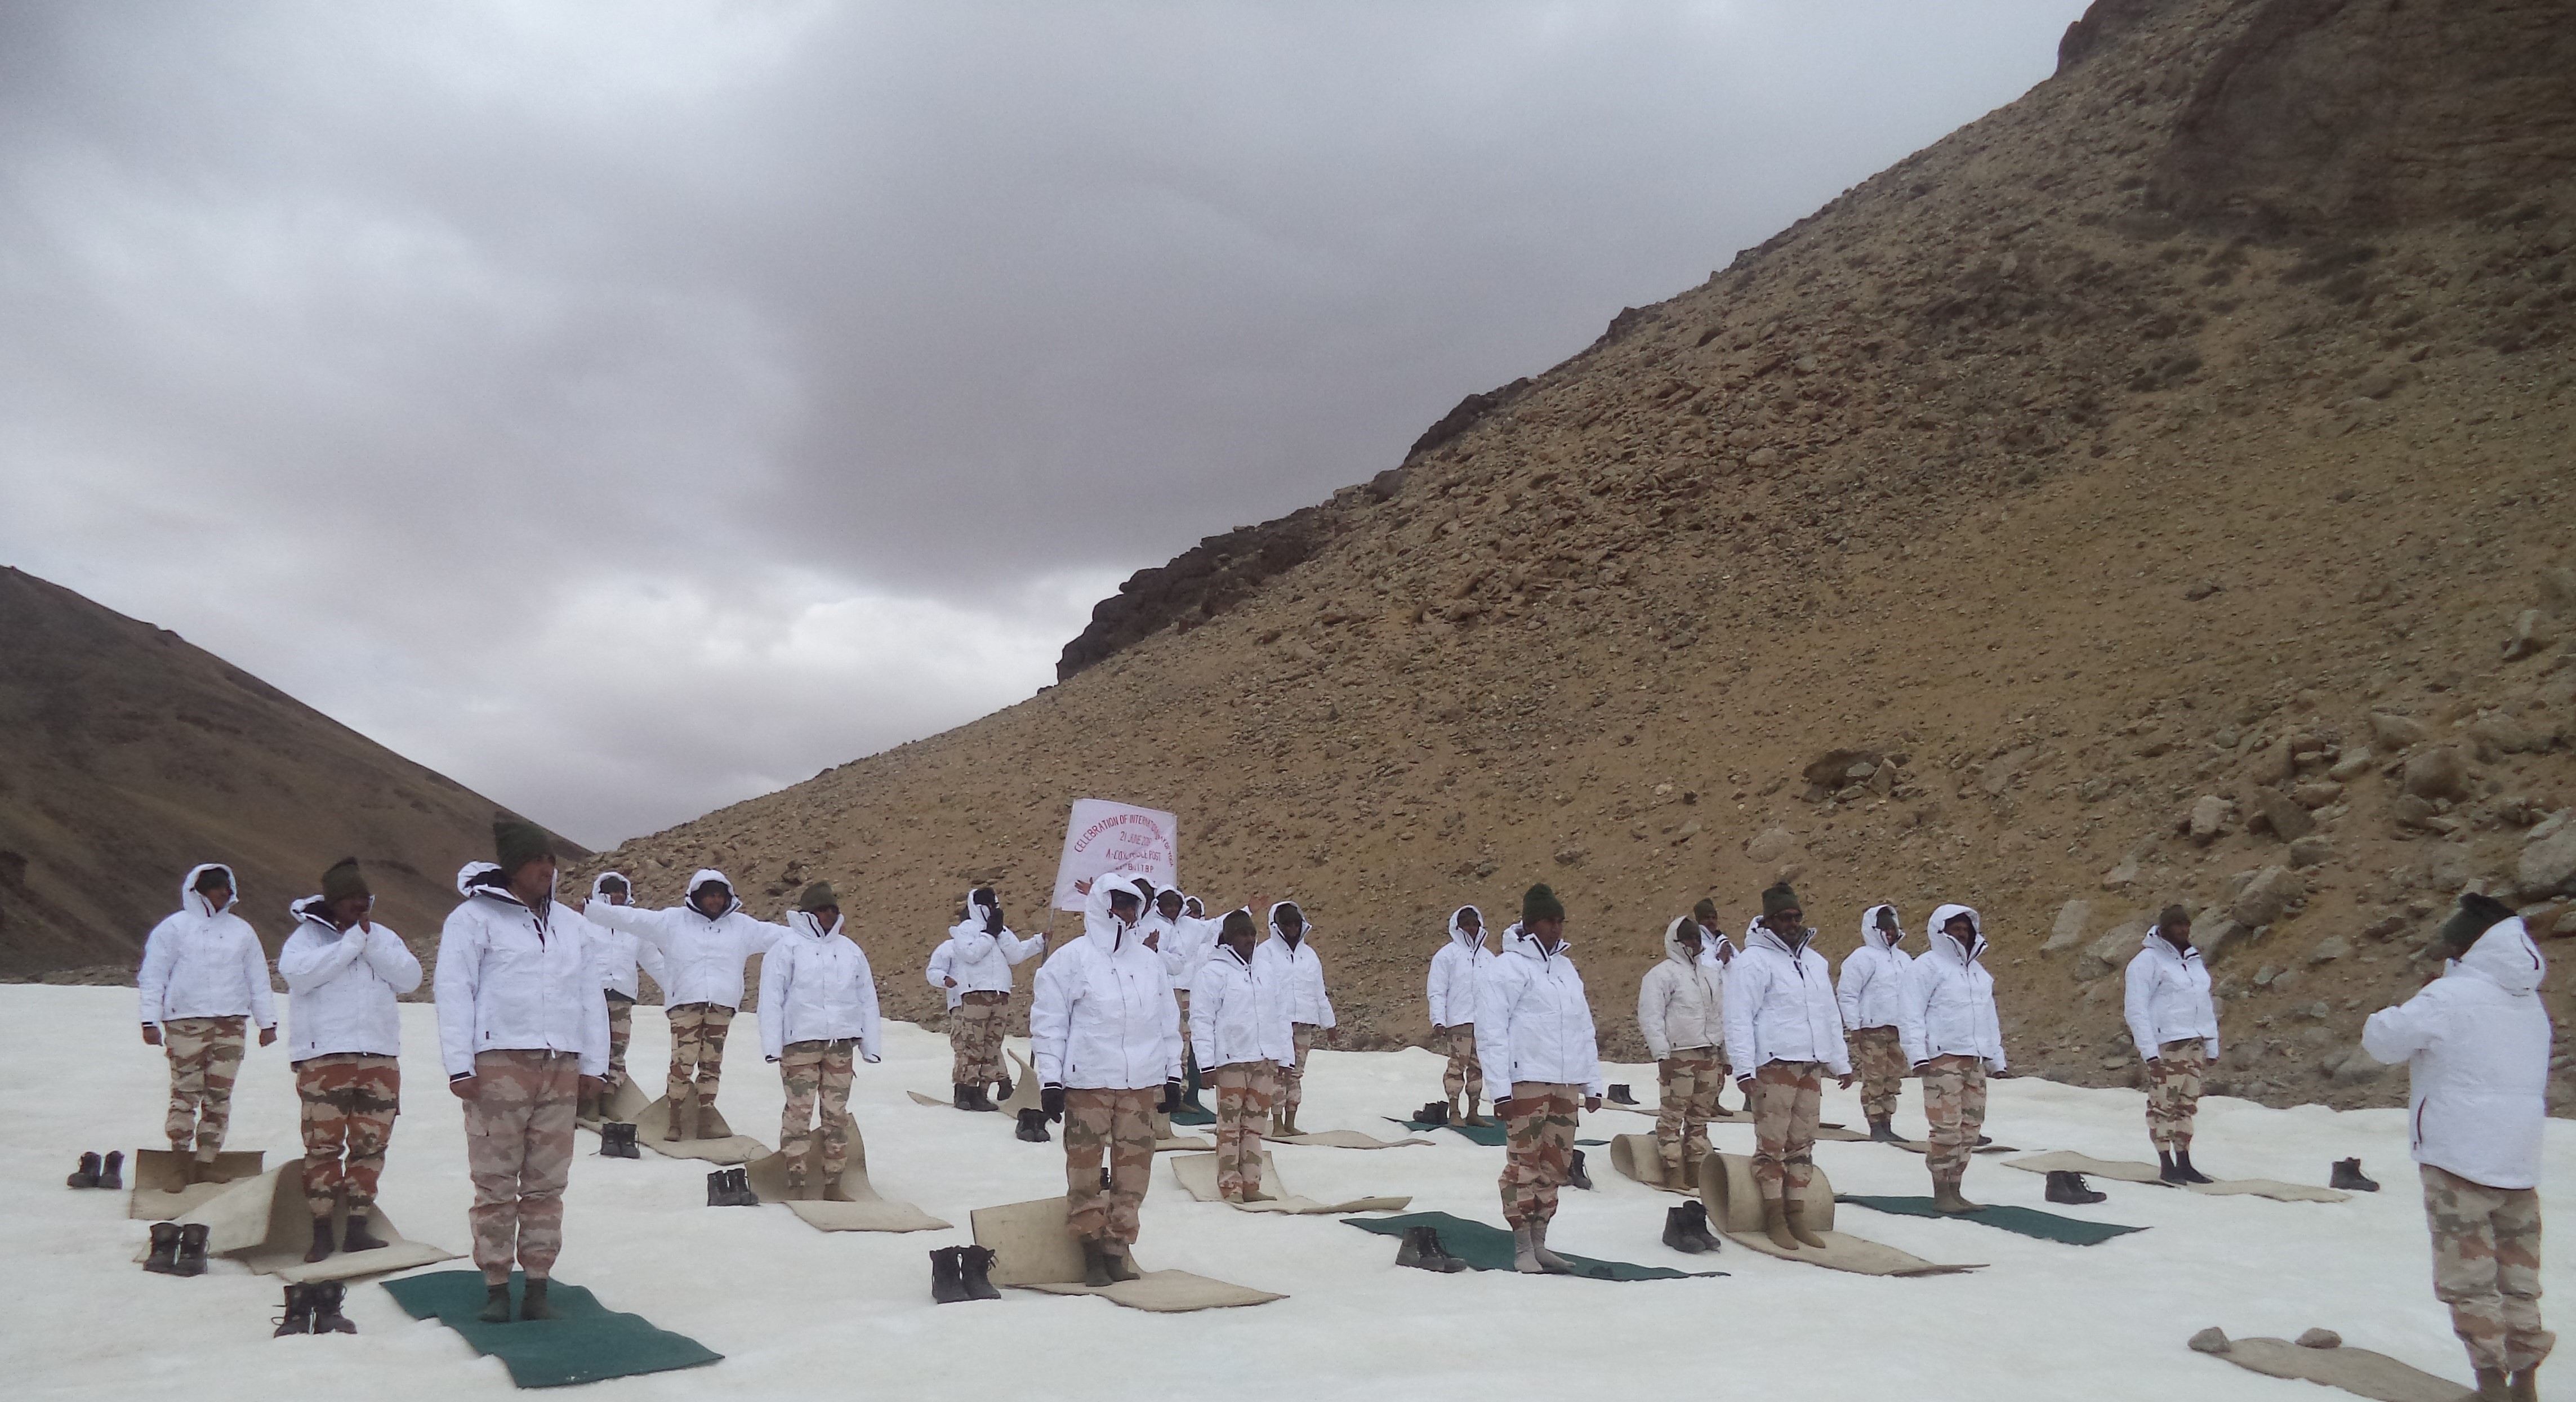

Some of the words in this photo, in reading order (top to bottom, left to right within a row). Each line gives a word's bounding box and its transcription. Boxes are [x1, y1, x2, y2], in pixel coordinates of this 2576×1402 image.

[1074, 816, 1119, 852] CELEBRATION
[1120, 814, 1127, 824] OF
[1155, 834, 1167, 843] DAY
[1120, 831, 1126, 842] 21
[1127, 833, 1142, 845] JUNE
[1149, 850, 1161, 861] POST
[1137, 864, 1154, 873] ITBP
